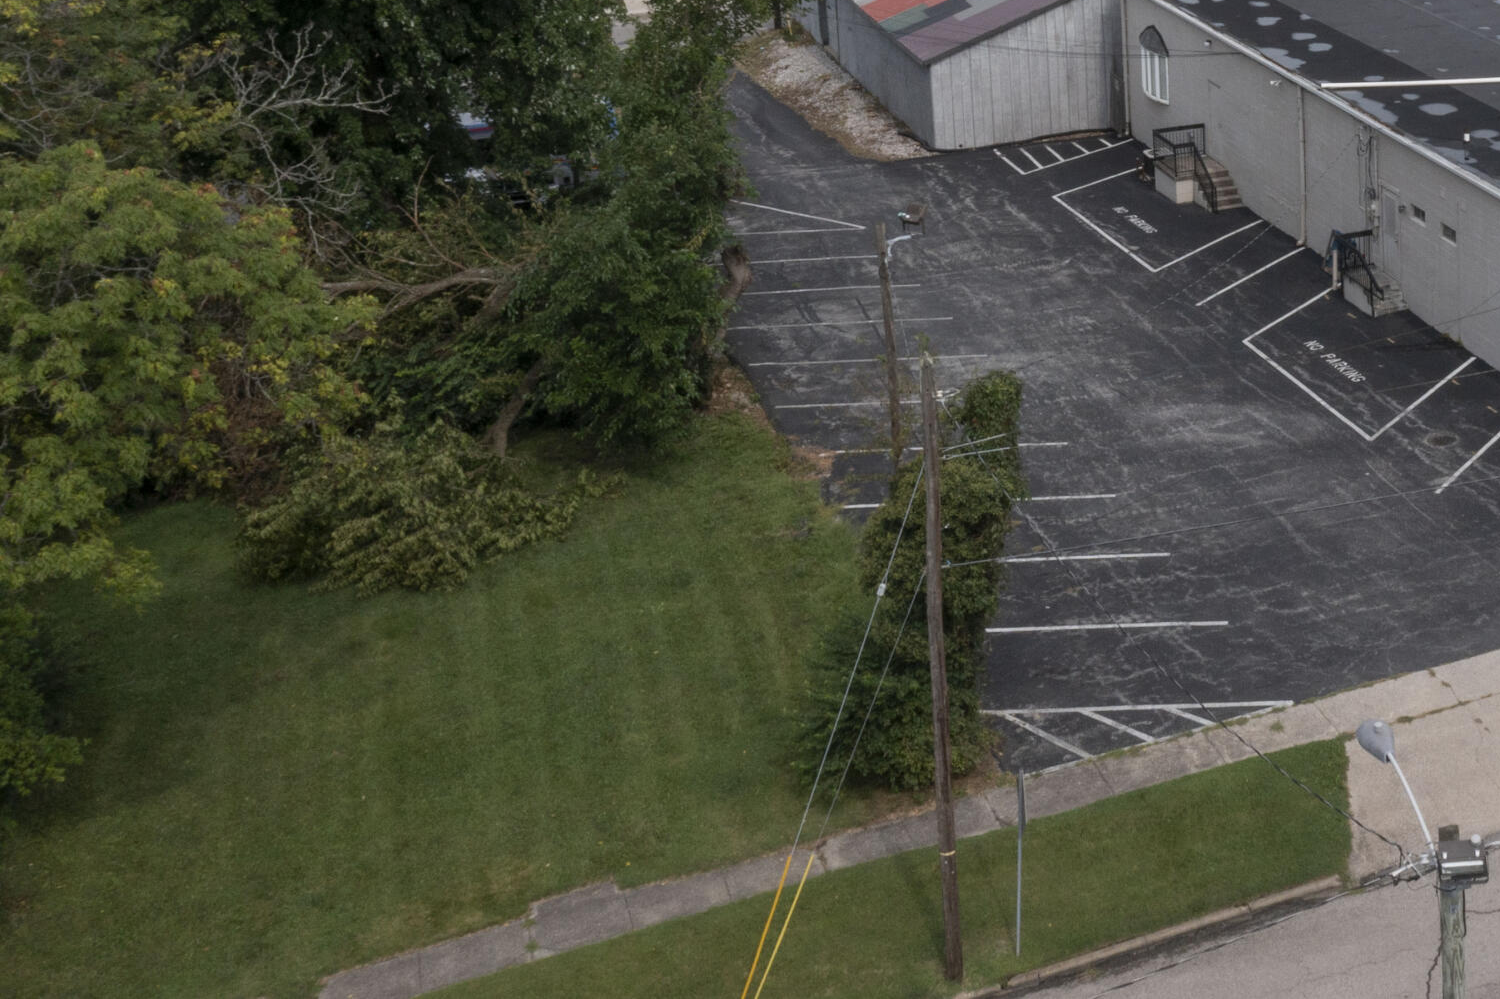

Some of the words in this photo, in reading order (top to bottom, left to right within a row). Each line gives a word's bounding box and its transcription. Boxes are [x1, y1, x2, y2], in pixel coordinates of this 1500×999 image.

[1112, 206, 1129, 214] NO
[1124, 214, 1158, 234] PARKING
[1303, 340, 1325, 351] NO
[1320, 353, 1366, 383] PARKING
